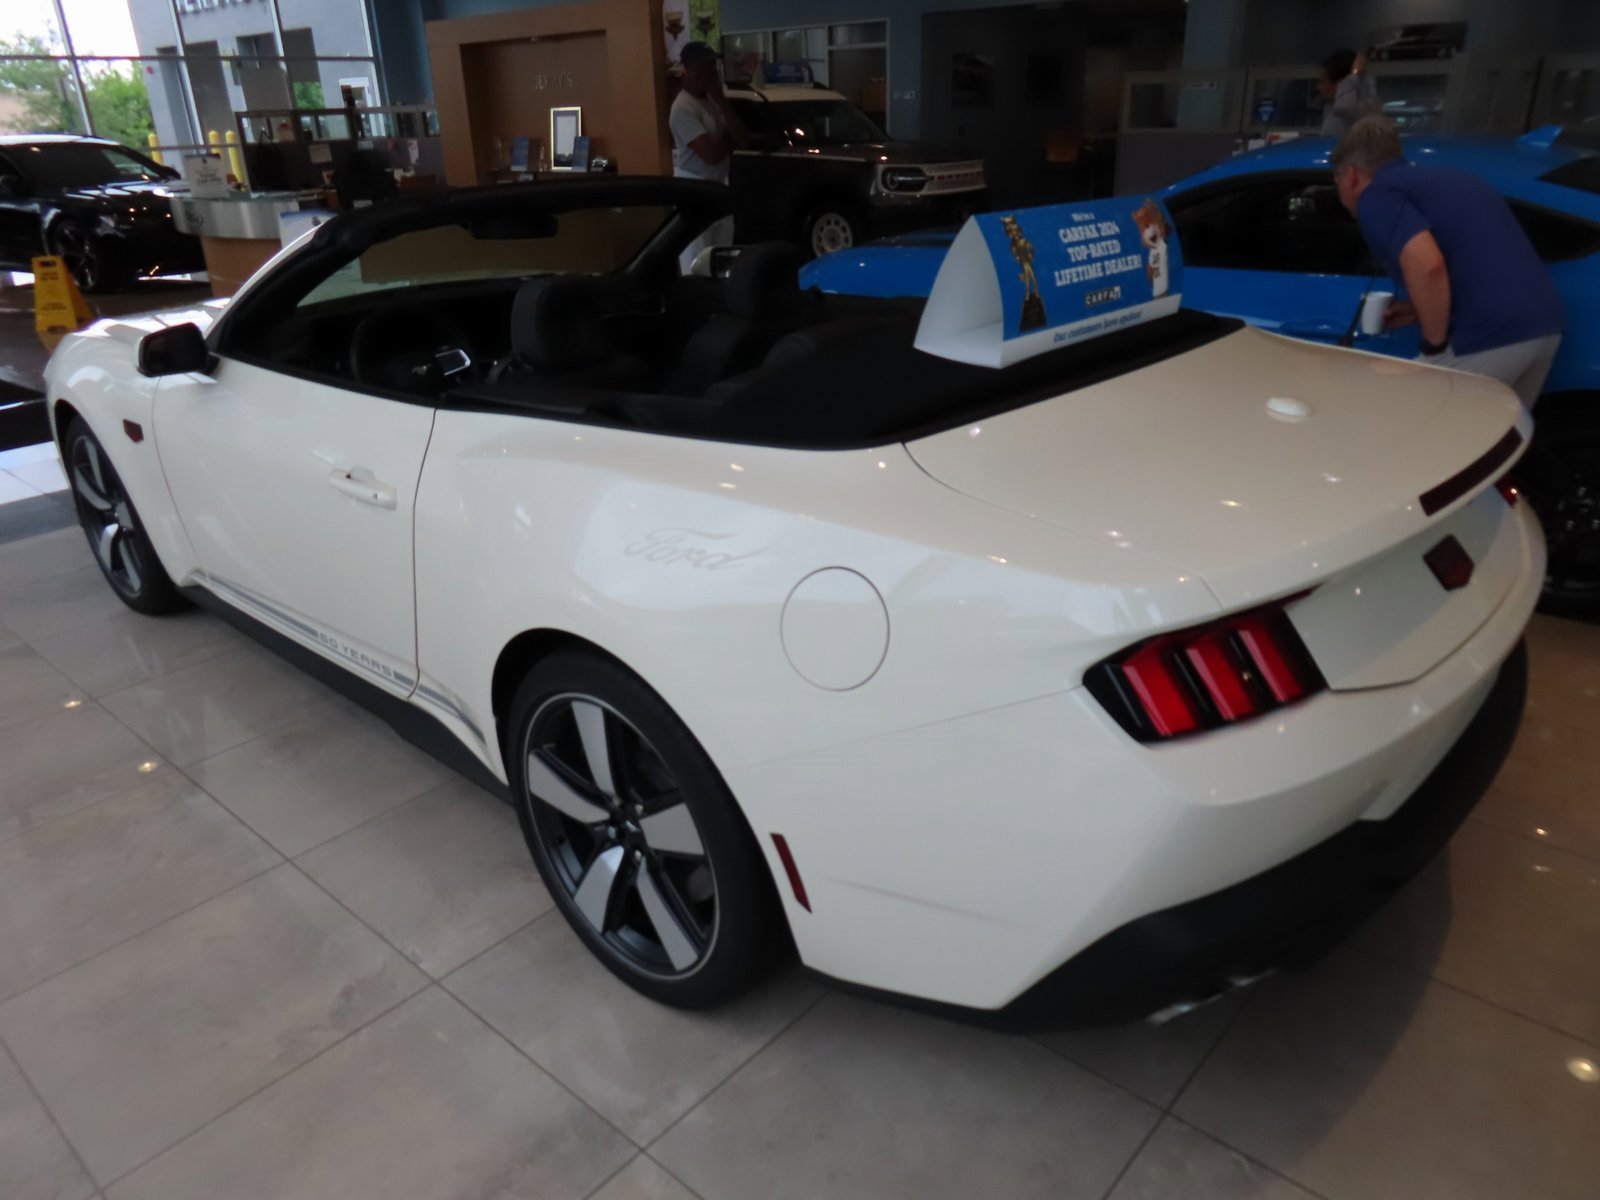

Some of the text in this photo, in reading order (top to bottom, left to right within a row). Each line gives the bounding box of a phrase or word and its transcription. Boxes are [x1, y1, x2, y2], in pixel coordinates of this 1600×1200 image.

[1059, 221, 1120, 243] CARFAX 2024
[1067, 239, 1121, 262] TOP-RATED
[1054, 262, 1104, 287] LIFETIME
[1104, 254, 1143, 275] DEALER!
[621, 527, 772, 570] Ford
[319, 632, 392, 676] 60 YEARS
